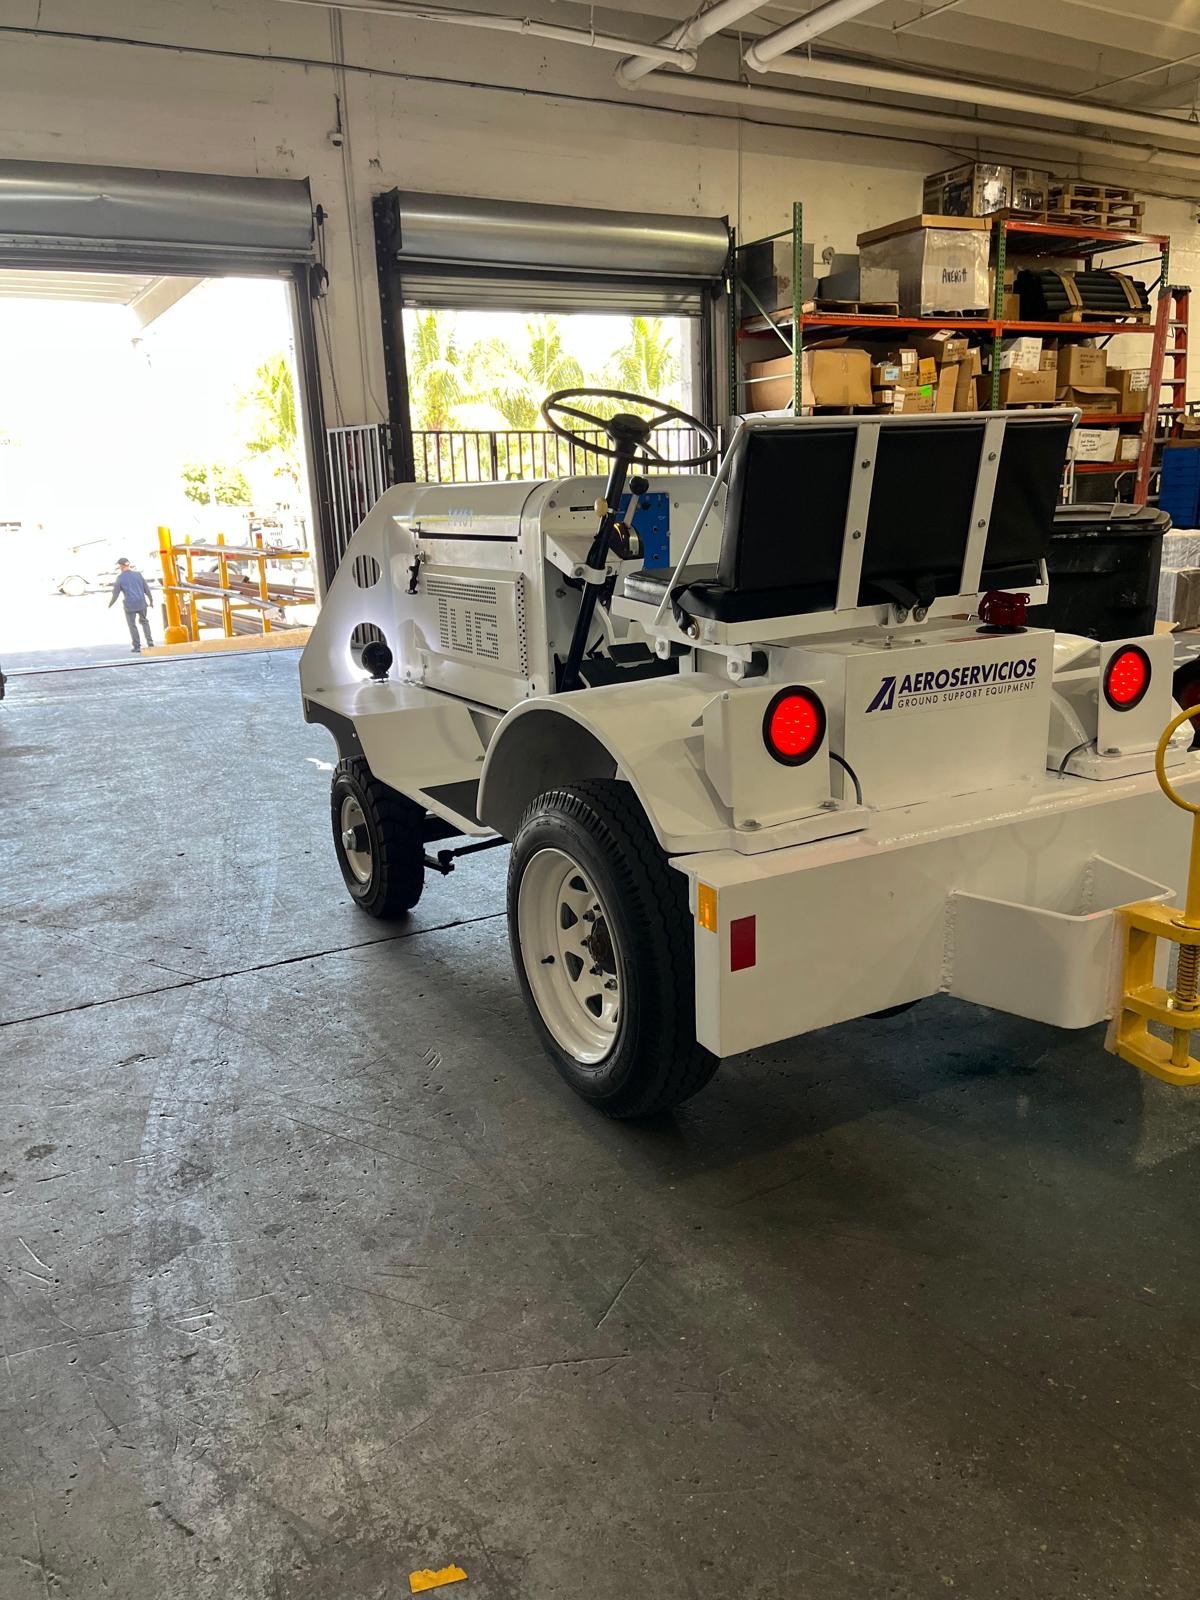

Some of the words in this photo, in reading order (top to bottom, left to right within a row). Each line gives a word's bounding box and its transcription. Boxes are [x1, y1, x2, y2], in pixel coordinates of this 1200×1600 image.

[898, 658, 1037, 694] AEROSERVICIOS
[897, 695, 939, 709] GROUND
[942, 688, 983, 702] SUPPORT
[985, 681, 1035, 697] EQUIPMENT
